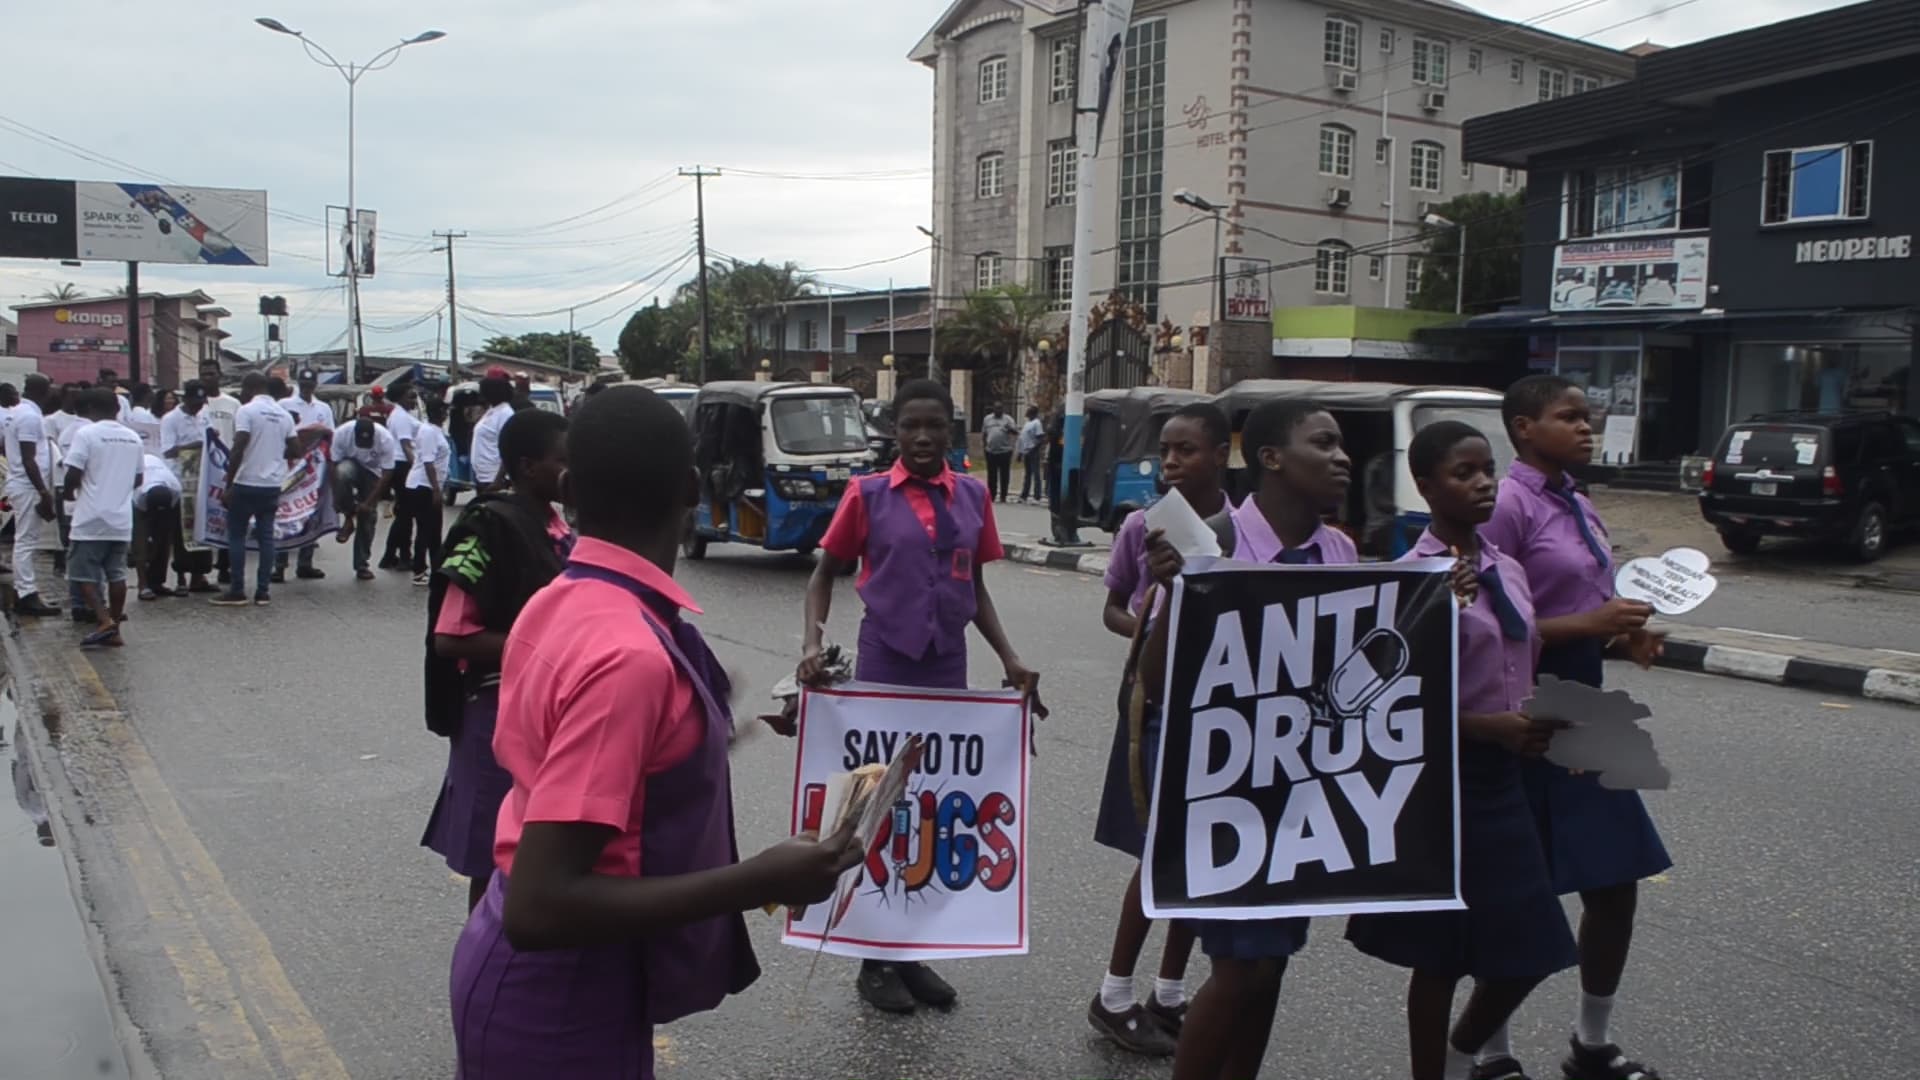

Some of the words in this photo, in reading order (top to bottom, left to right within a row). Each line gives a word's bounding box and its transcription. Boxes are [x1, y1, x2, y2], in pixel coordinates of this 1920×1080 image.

[83, 210, 122, 223] SPARK
[67, 310, 124, 328] konga
[1228, 297, 1270, 316] HOTEL
[1631, 563, 1665, 587] MENTAL
[1665, 581, 1701, 600] HEALTH
[1631, 578, 1685, 606] AWARENESS
[1664, 569, 1688, 584] TEEN
[1191, 580, 1400, 710] ANTI
[843, 728, 899, 773] SAY
[949, 733, 984, 777] TO
[1185, 675, 1425, 801] DRUG
[1185, 761, 1427, 899] DAY
